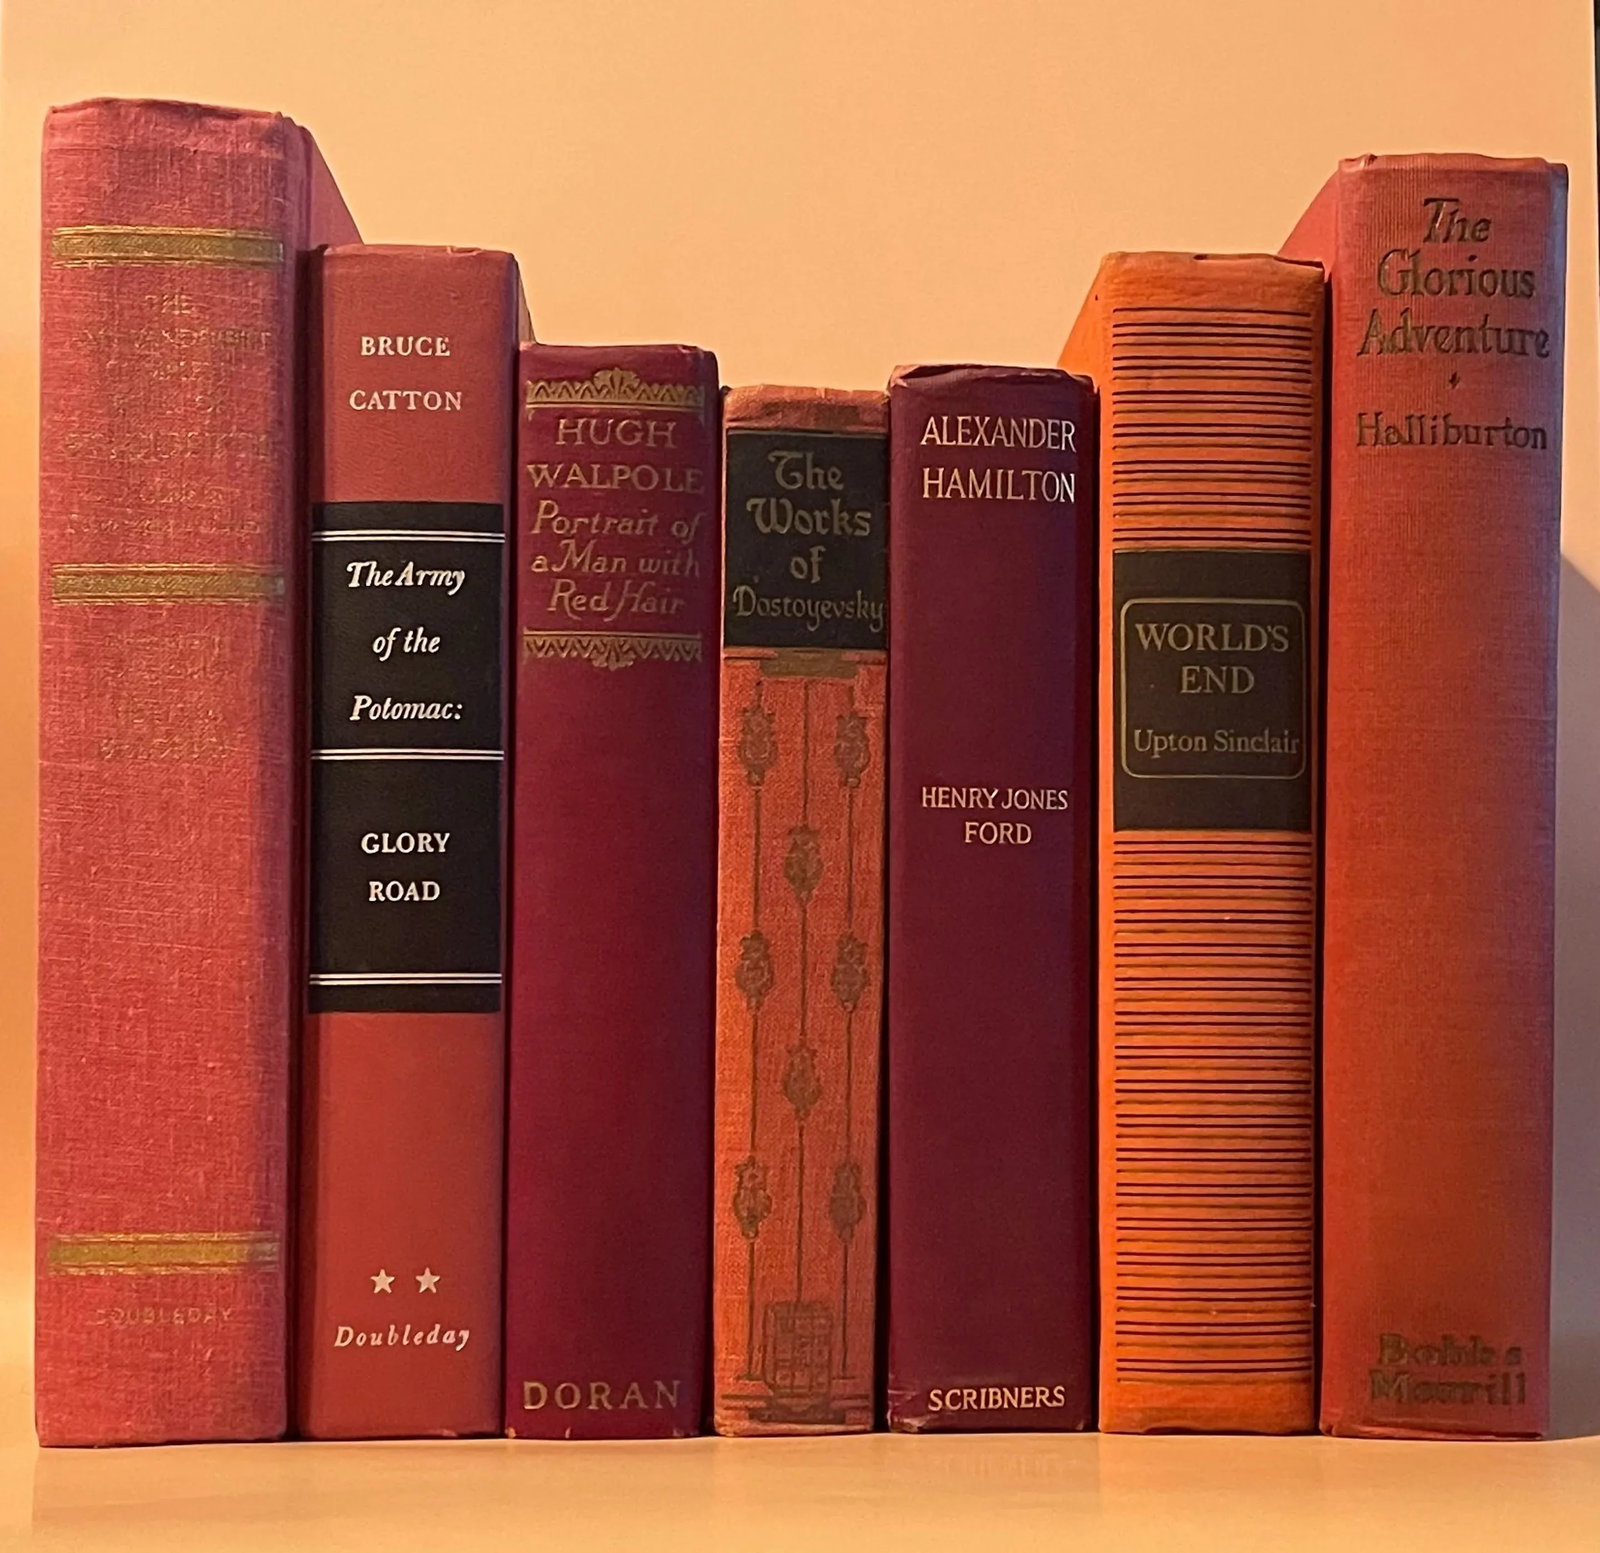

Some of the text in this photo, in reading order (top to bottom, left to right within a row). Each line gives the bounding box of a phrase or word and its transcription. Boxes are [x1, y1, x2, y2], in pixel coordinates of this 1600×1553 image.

[1424, 197, 1492, 243] The
[1377, 248, 1536, 299] Glorious
[360, 336, 451, 356] BRUCE
[1357, 306, 1550, 358] Adventure
[349, 390, 463, 411] CATTON
[556, 418, 677, 448] HUGH
[920, 416, 1077, 453] ALEXANDER
[1357, 411, 1548, 450] Halliburton
[526, 463, 704, 494] WALPOLE
[768, 450, 844, 490] The
[922, 467, 1075, 503] HAMILTON
[531, 500, 706, 545] Portrait of
[746, 497, 872, 537] Works
[531, 539, 699, 577] a Man with
[790, 545, 826, 583] of
[346, 561, 465, 595] The Army
[547, 578, 686, 622] Red Hair
[732, 585, 884, 632] Dostoyevsky
[373, 626, 441, 661] of the
[1135, 623, 1289, 652] WORLD'S
[1180, 665, 1255, 694] END
[350, 695, 463, 721] Potomac:
[1134, 727, 1299, 759] Upton Sinclair
[922, 786, 1069, 810] HENRY JONES
[361, 832, 450, 854] GLORY
[965, 821, 1032, 845] FORD
[368, 881, 440, 902] ROAD
[334, 1323, 470, 1351] Doubleday
[522, 1380, 681, 1411] DORAN
[928, 1386, 1066, 1412] SCRIBNERS
